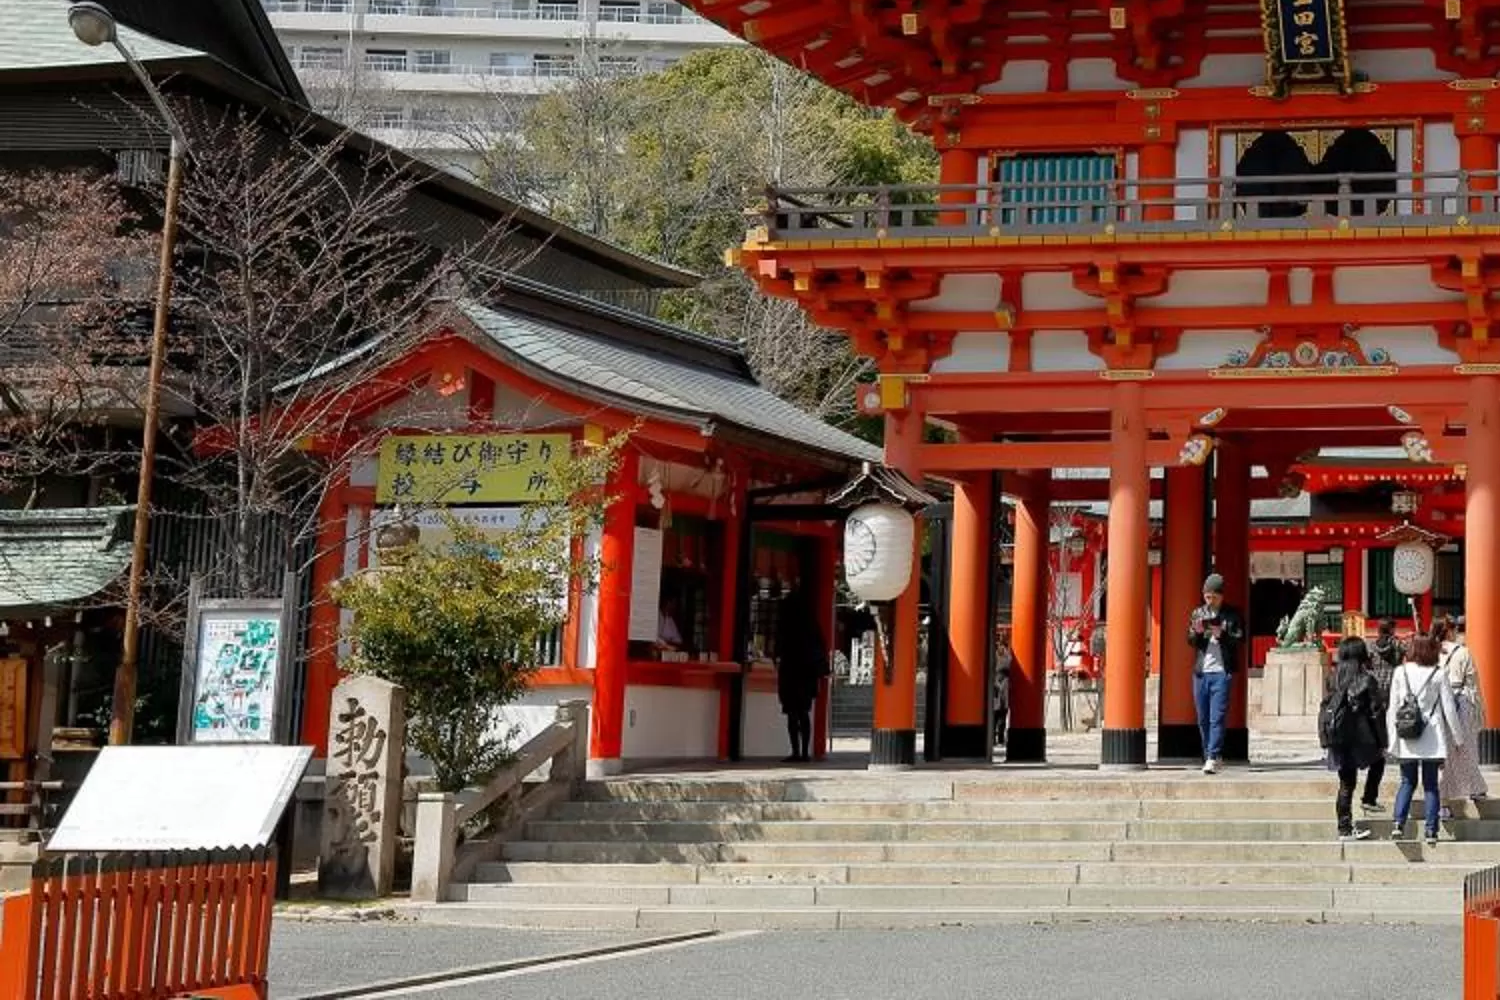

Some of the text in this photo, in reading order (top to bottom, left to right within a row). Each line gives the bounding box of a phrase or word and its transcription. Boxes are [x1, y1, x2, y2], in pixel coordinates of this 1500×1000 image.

[395, 439, 552, 467] 縁結び御守り
